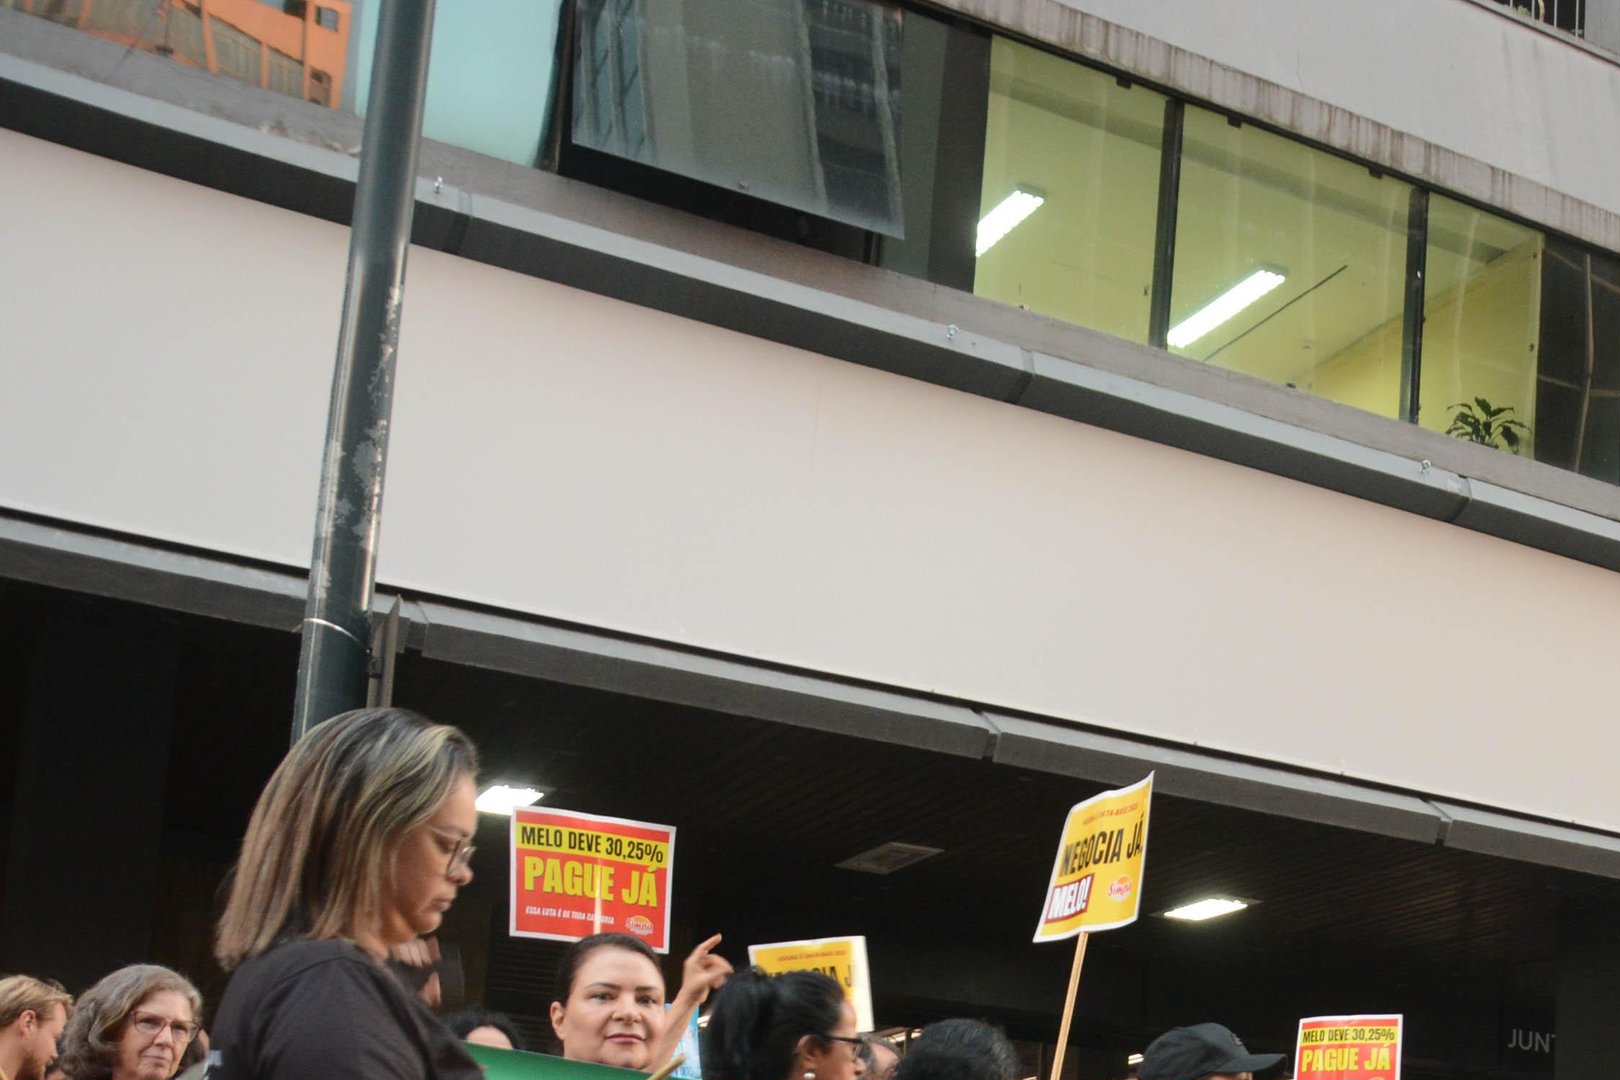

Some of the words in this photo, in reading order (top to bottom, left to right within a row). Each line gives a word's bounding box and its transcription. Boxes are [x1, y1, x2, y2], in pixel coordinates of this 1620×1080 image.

[521, 825, 563, 848] MELO
[568, 831, 602, 853] DEVE
[605, 836, 664, 864] 30,25%
[1059, 828, 1125, 877] NEGOCIA
[524, 855, 615, 902] PAGUE
[621, 865, 658, 908] JÁ
[1048, 876, 1093, 920] MELO!
[1108, 881, 1132, 897] Simpa
[1302, 1029, 1325, 1044] MELO
[1328, 1028, 1350, 1042] DEVE
[1352, 1027, 1395, 1042] 30,25%
[1301, 1048, 1359, 1073] PAGUE
[1363, 1043, 1391, 1071] JÁ
